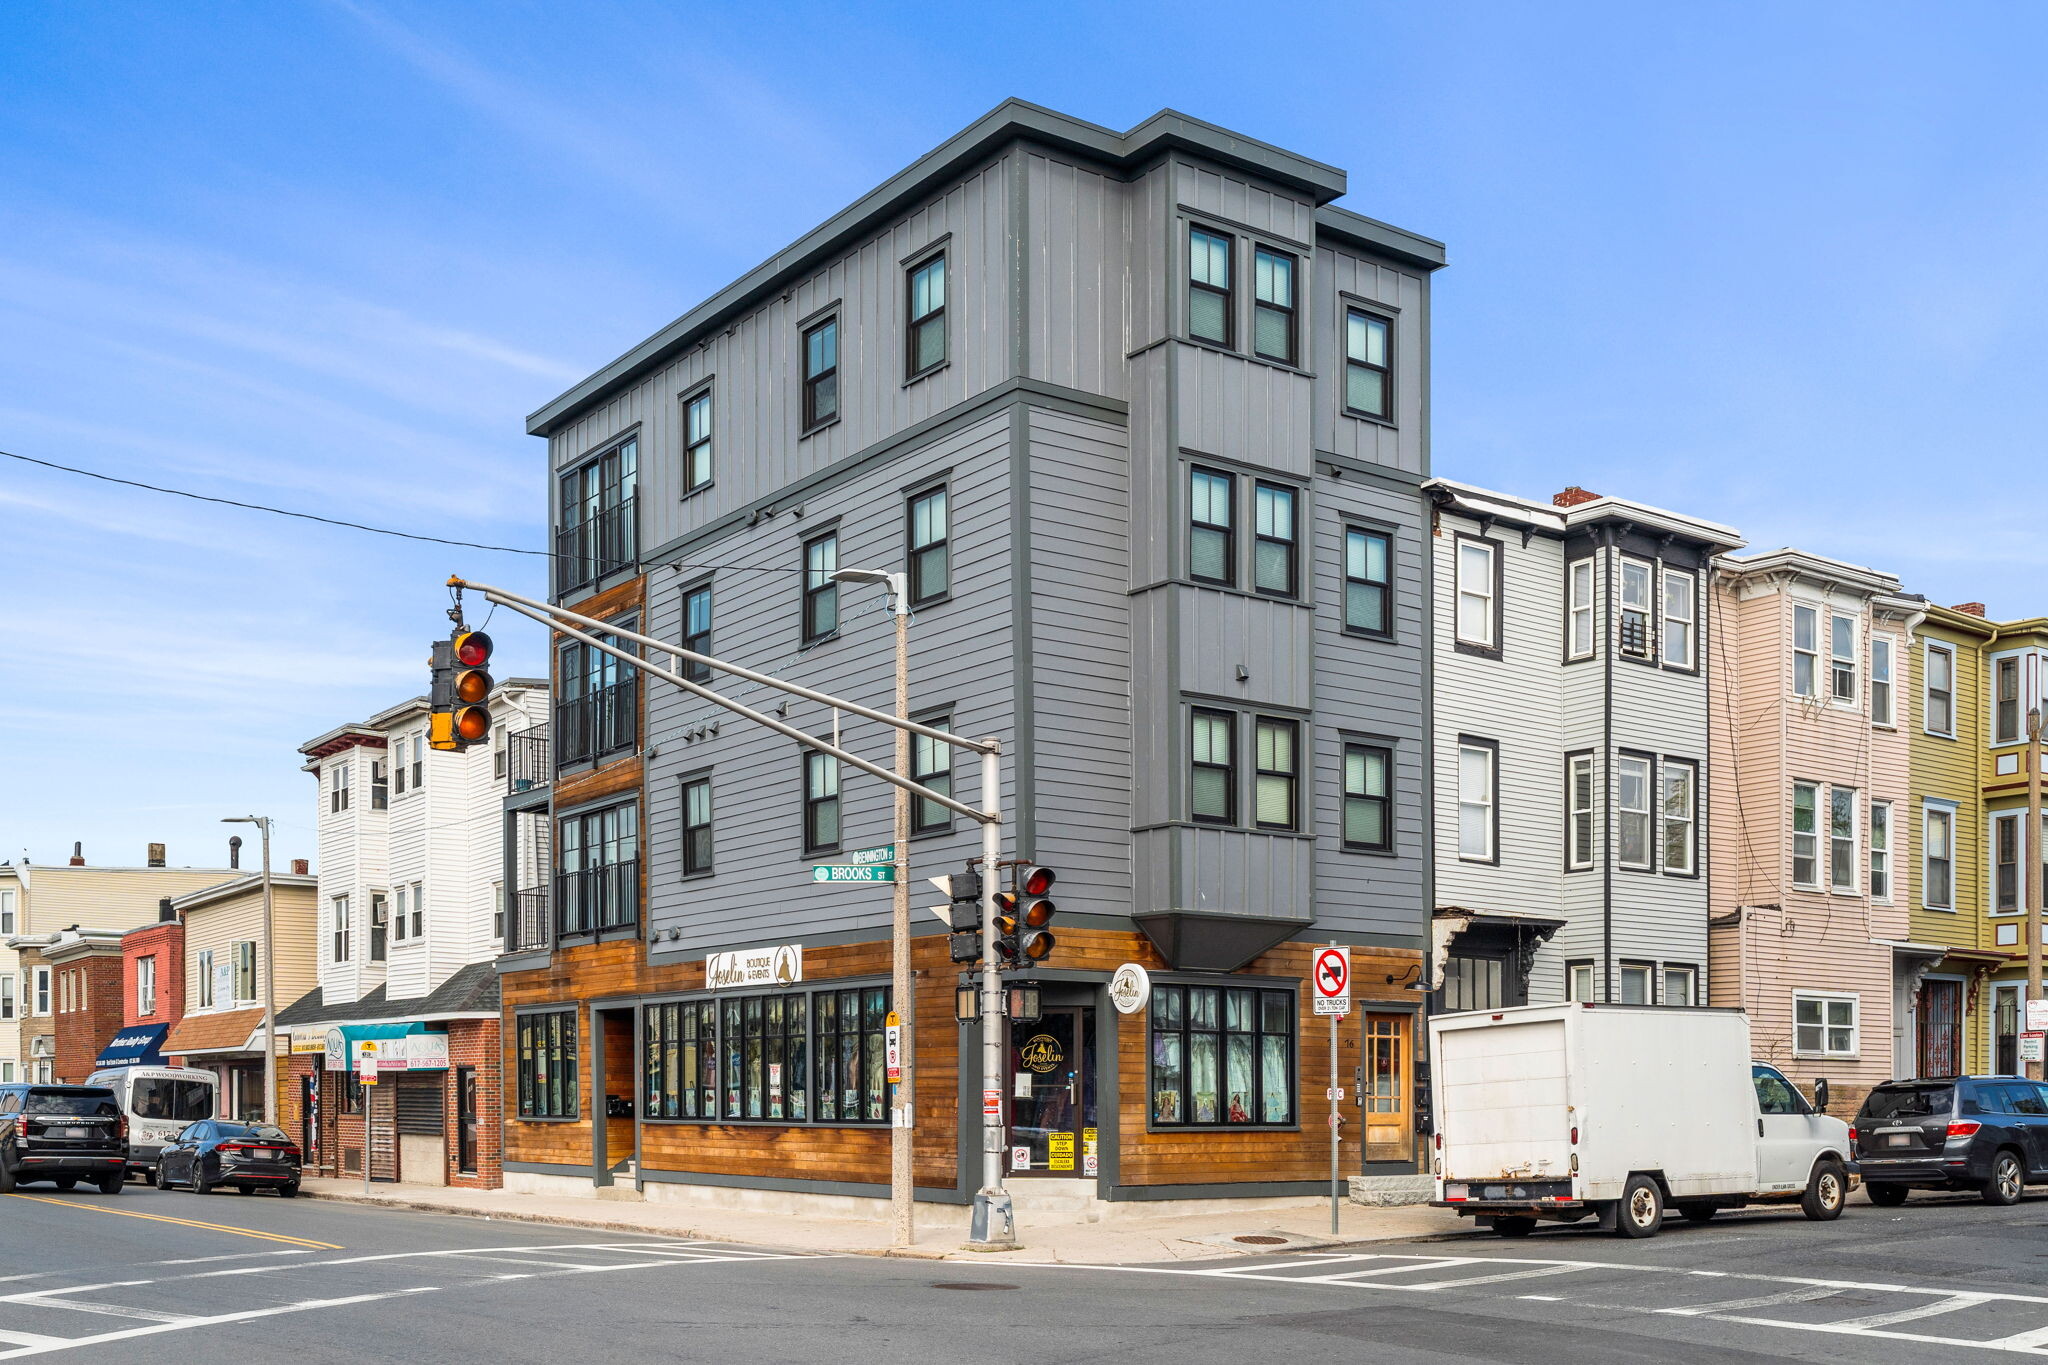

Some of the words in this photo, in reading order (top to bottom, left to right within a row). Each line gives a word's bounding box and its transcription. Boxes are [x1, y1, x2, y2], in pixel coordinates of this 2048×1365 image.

[859, 848, 888, 864] BENNINGTON
[888, 852, 893, 860] ST
[831, 867, 872, 880] BROOKS
[878, 871, 886, 880] ST
[746, 957, 771, 968] BOUTIQUE
[704, 953, 745, 993] Joselin
[752, 969, 770, 979] EVENTS
[1114, 978, 1140, 1001] Joselin
[1021, 1043, 1064, 1068] Joselin
[410, 1060, 447, 1068] 617-567-1205
[156, 1072, 208, 1081] WOODWORKING
[1328, 1089, 1343, 1098] FC
